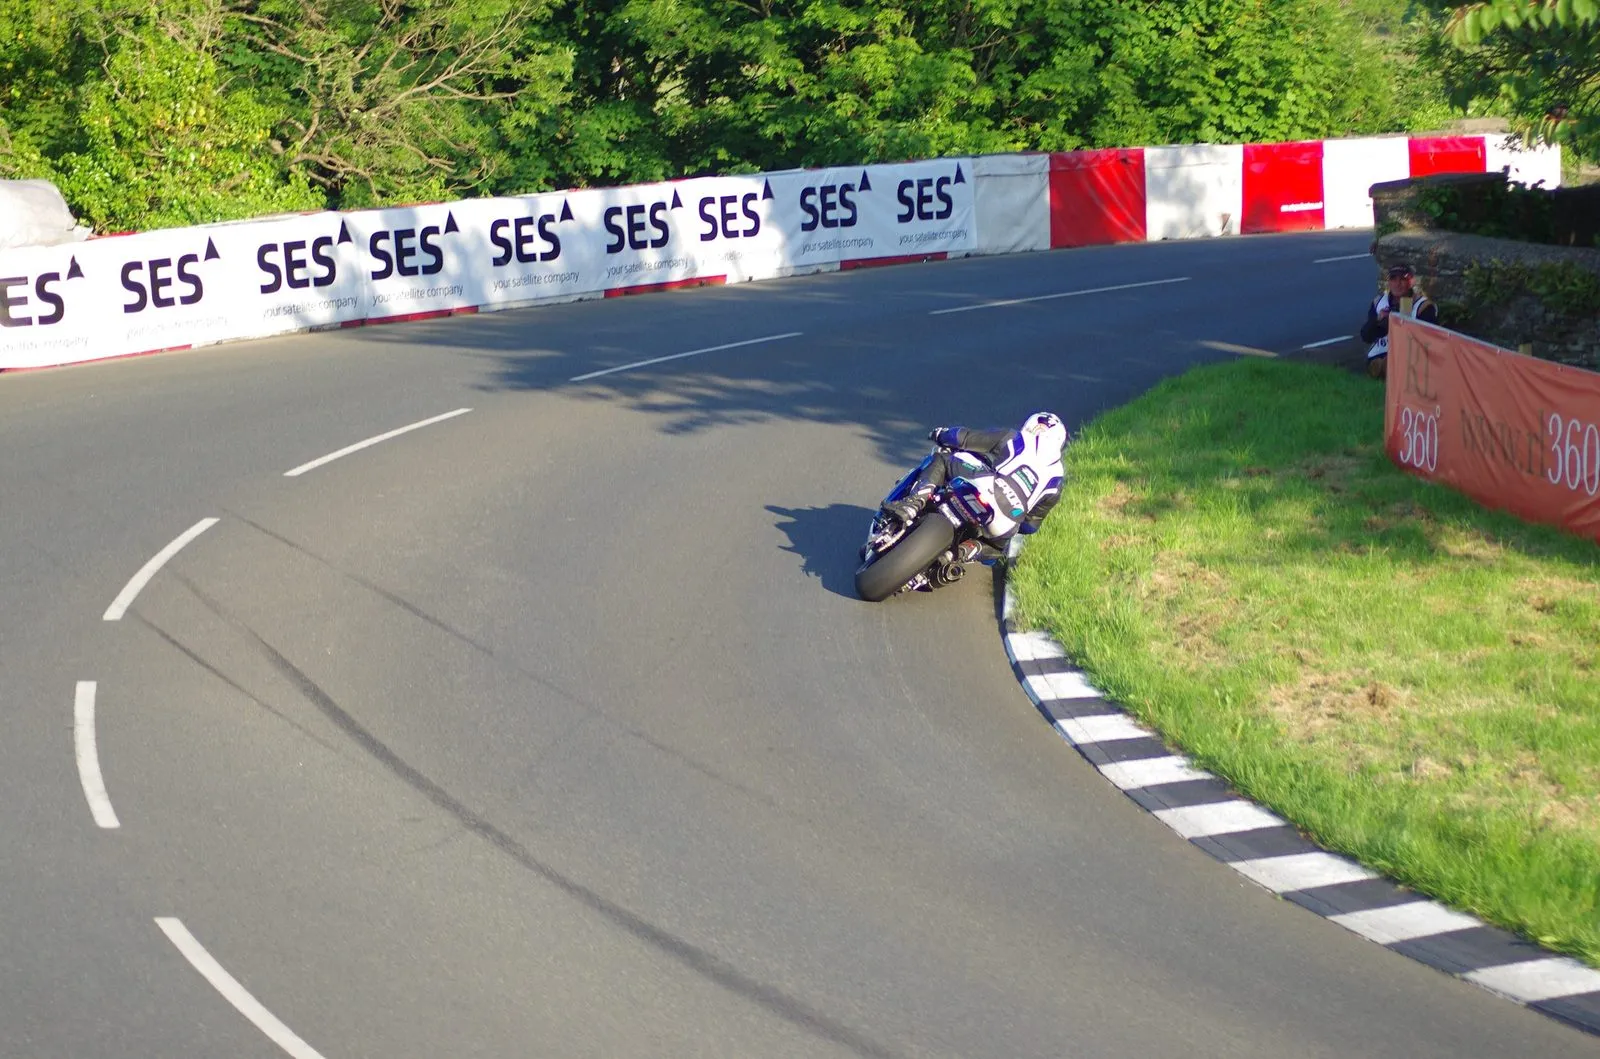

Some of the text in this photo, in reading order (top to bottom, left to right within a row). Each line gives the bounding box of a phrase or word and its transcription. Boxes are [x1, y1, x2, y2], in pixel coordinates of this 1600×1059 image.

[698, 192, 761, 242] SES
[799, 182, 858, 232] SES
[896, 175, 954, 224] SES
[369, 225, 444, 281] SES
[490, 214, 562, 267] SES
[603, 201, 670, 255] SES
[120, 253, 204, 314] SES
[257, 236, 337, 294] SES
[493, 270, 580, 292] your satellite company
[606, 264, 623, 278] your
[652, 257, 689, 273] company
[318, 295, 359, 311] company
[426, 284, 464, 298] company
